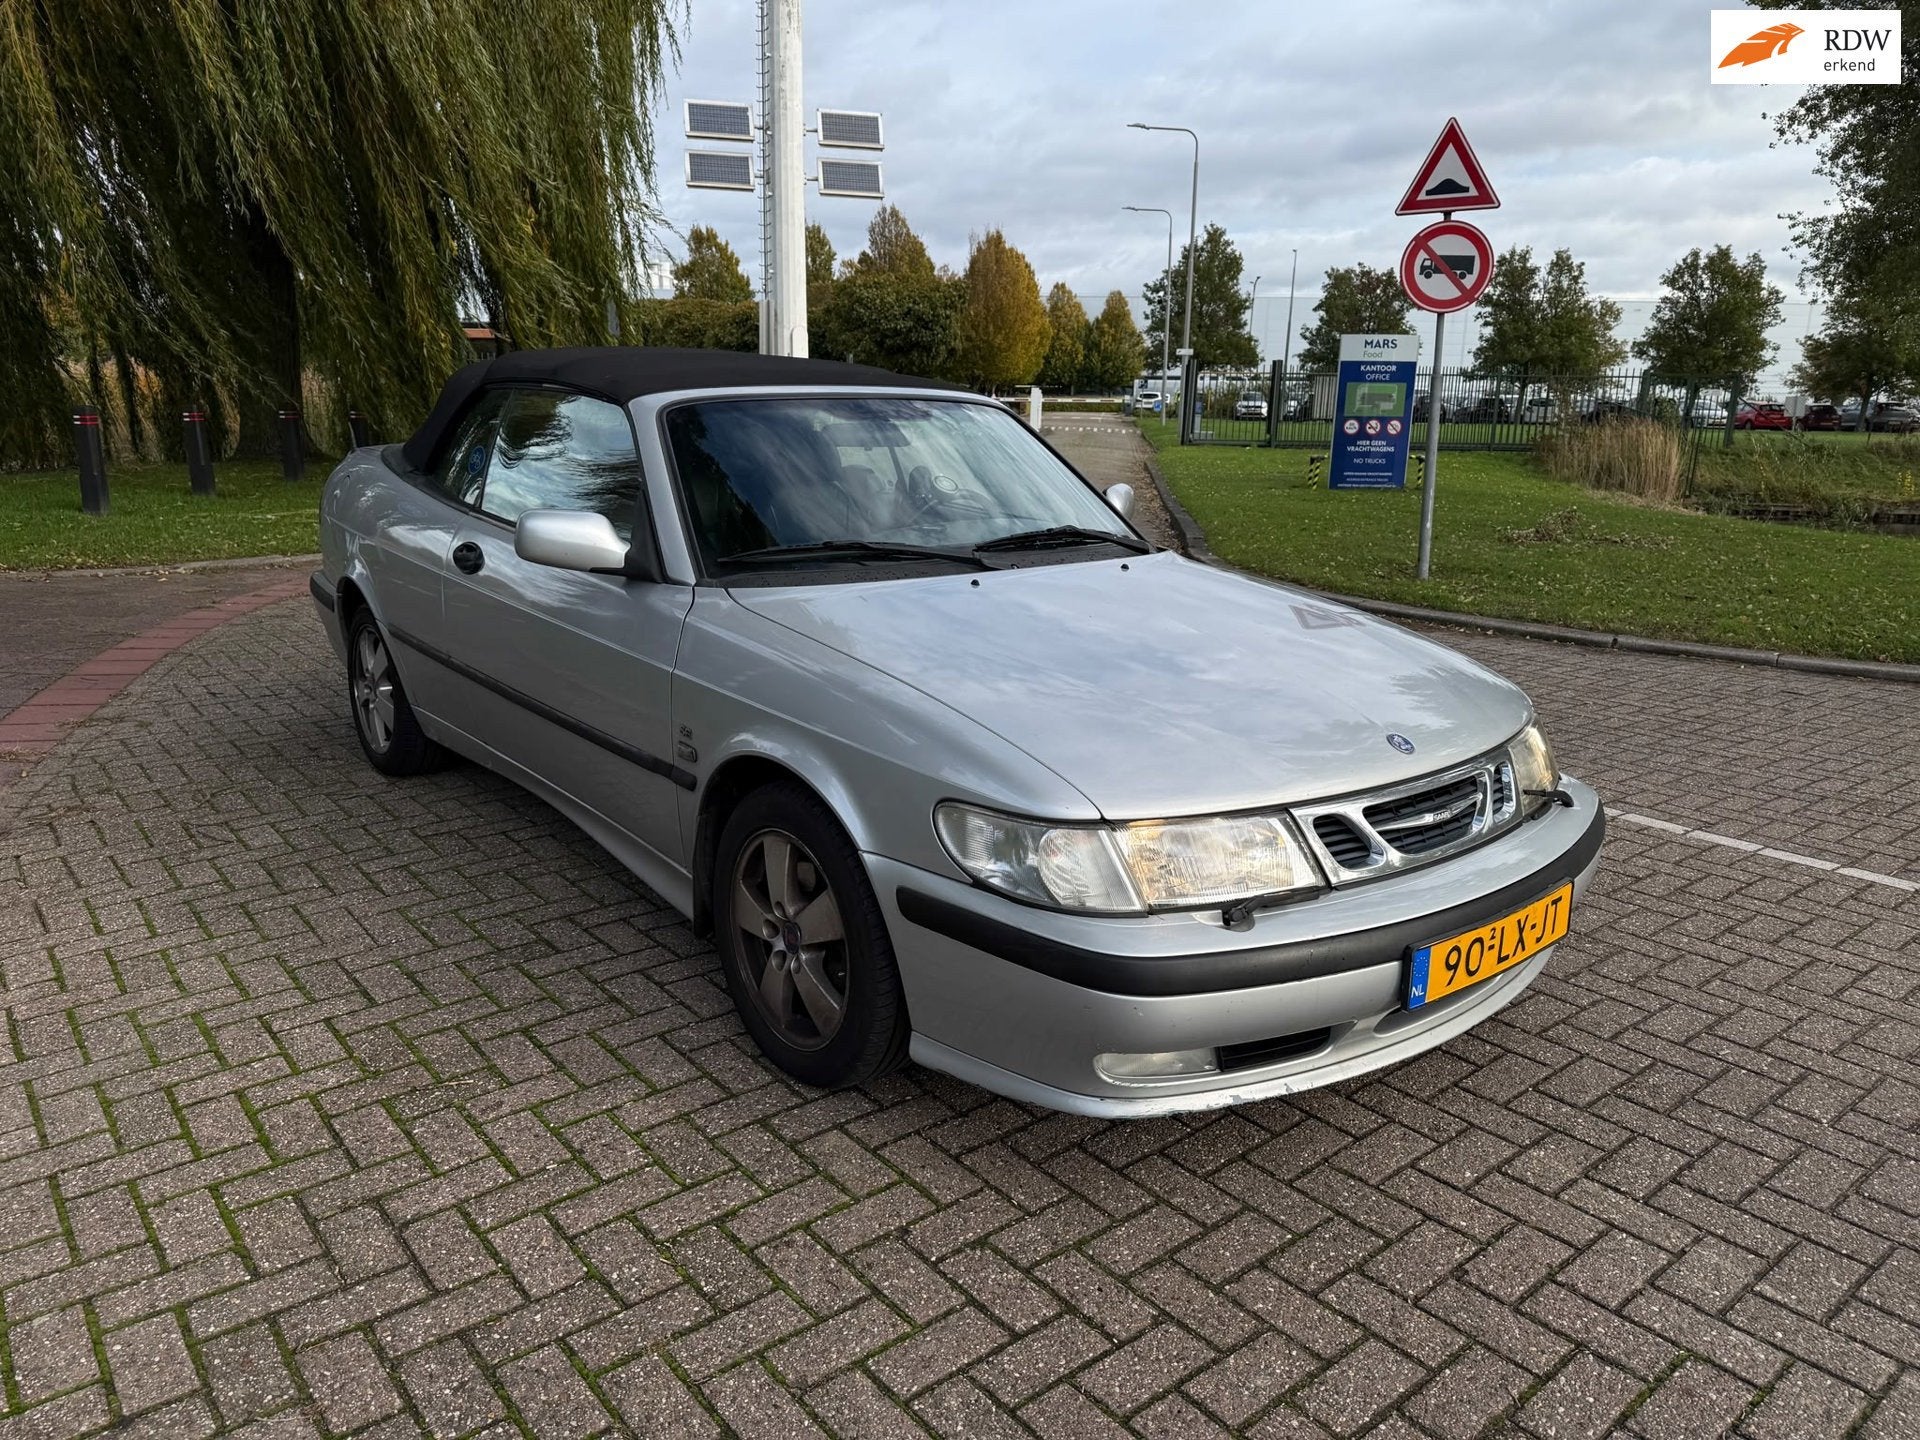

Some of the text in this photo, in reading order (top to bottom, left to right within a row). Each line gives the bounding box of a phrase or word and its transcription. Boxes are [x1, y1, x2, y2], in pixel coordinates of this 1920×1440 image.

[1363, 338, 1398, 349] MARS
[1363, 350, 1383, 358] Food
[1360, 364, 1397, 372] KANTOOR
[1365, 373, 1391, 381] OFFICE
[1410, 983, 1425, 998] NL
